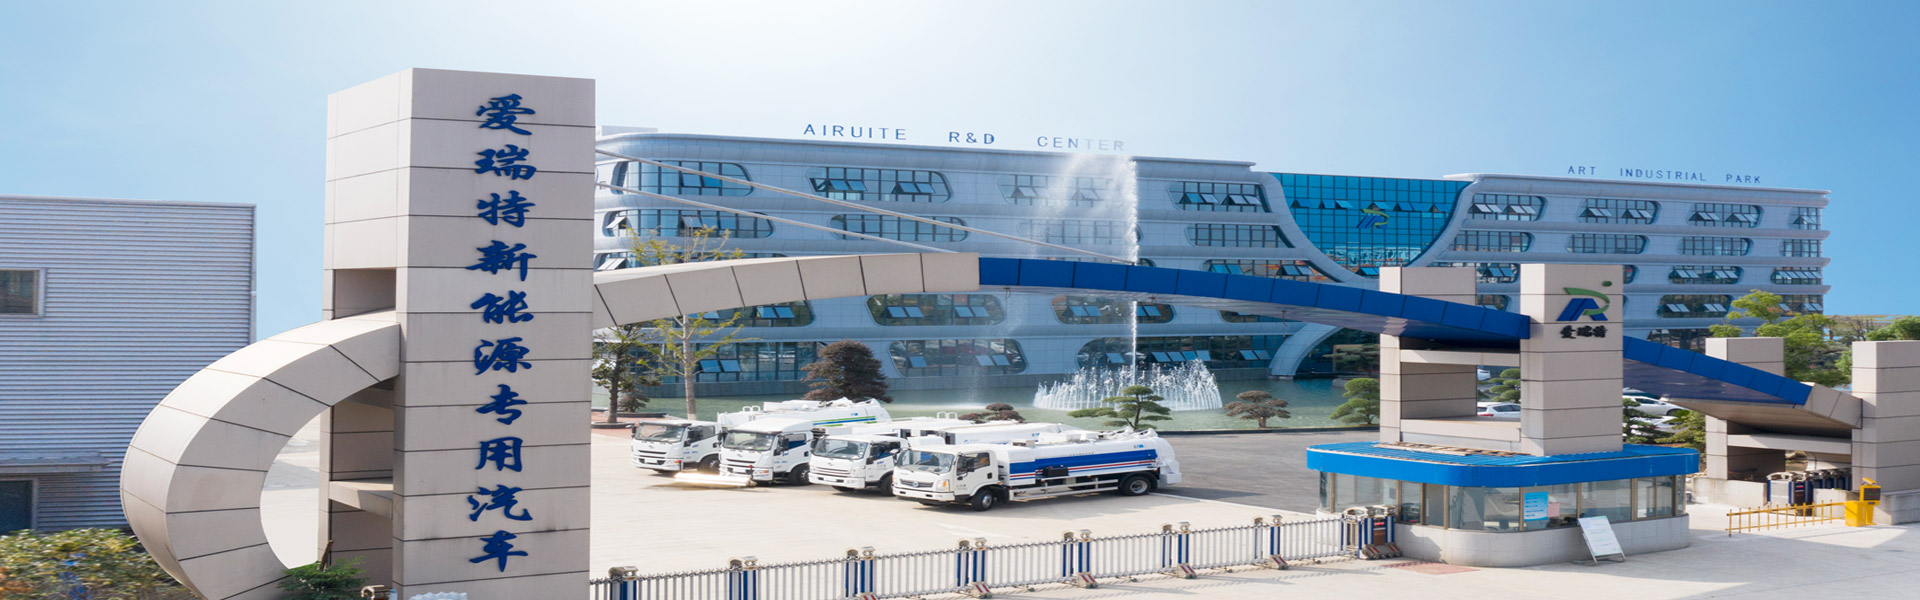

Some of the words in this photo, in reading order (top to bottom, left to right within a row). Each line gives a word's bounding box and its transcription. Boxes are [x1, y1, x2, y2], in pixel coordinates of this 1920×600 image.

[803, 123, 907, 141] AIRUITE
[948, 131, 995, 145] R&D
[1037, 135, 1124, 151] CENTER
[1567, 165, 1596, 176] ART
[1620, 167, 1707, 182] INDUSTRIAL
[1726, 173, 1761, 184] PARK
[466, 94, 537, 572] 爱瑞特新能源专用汽车
